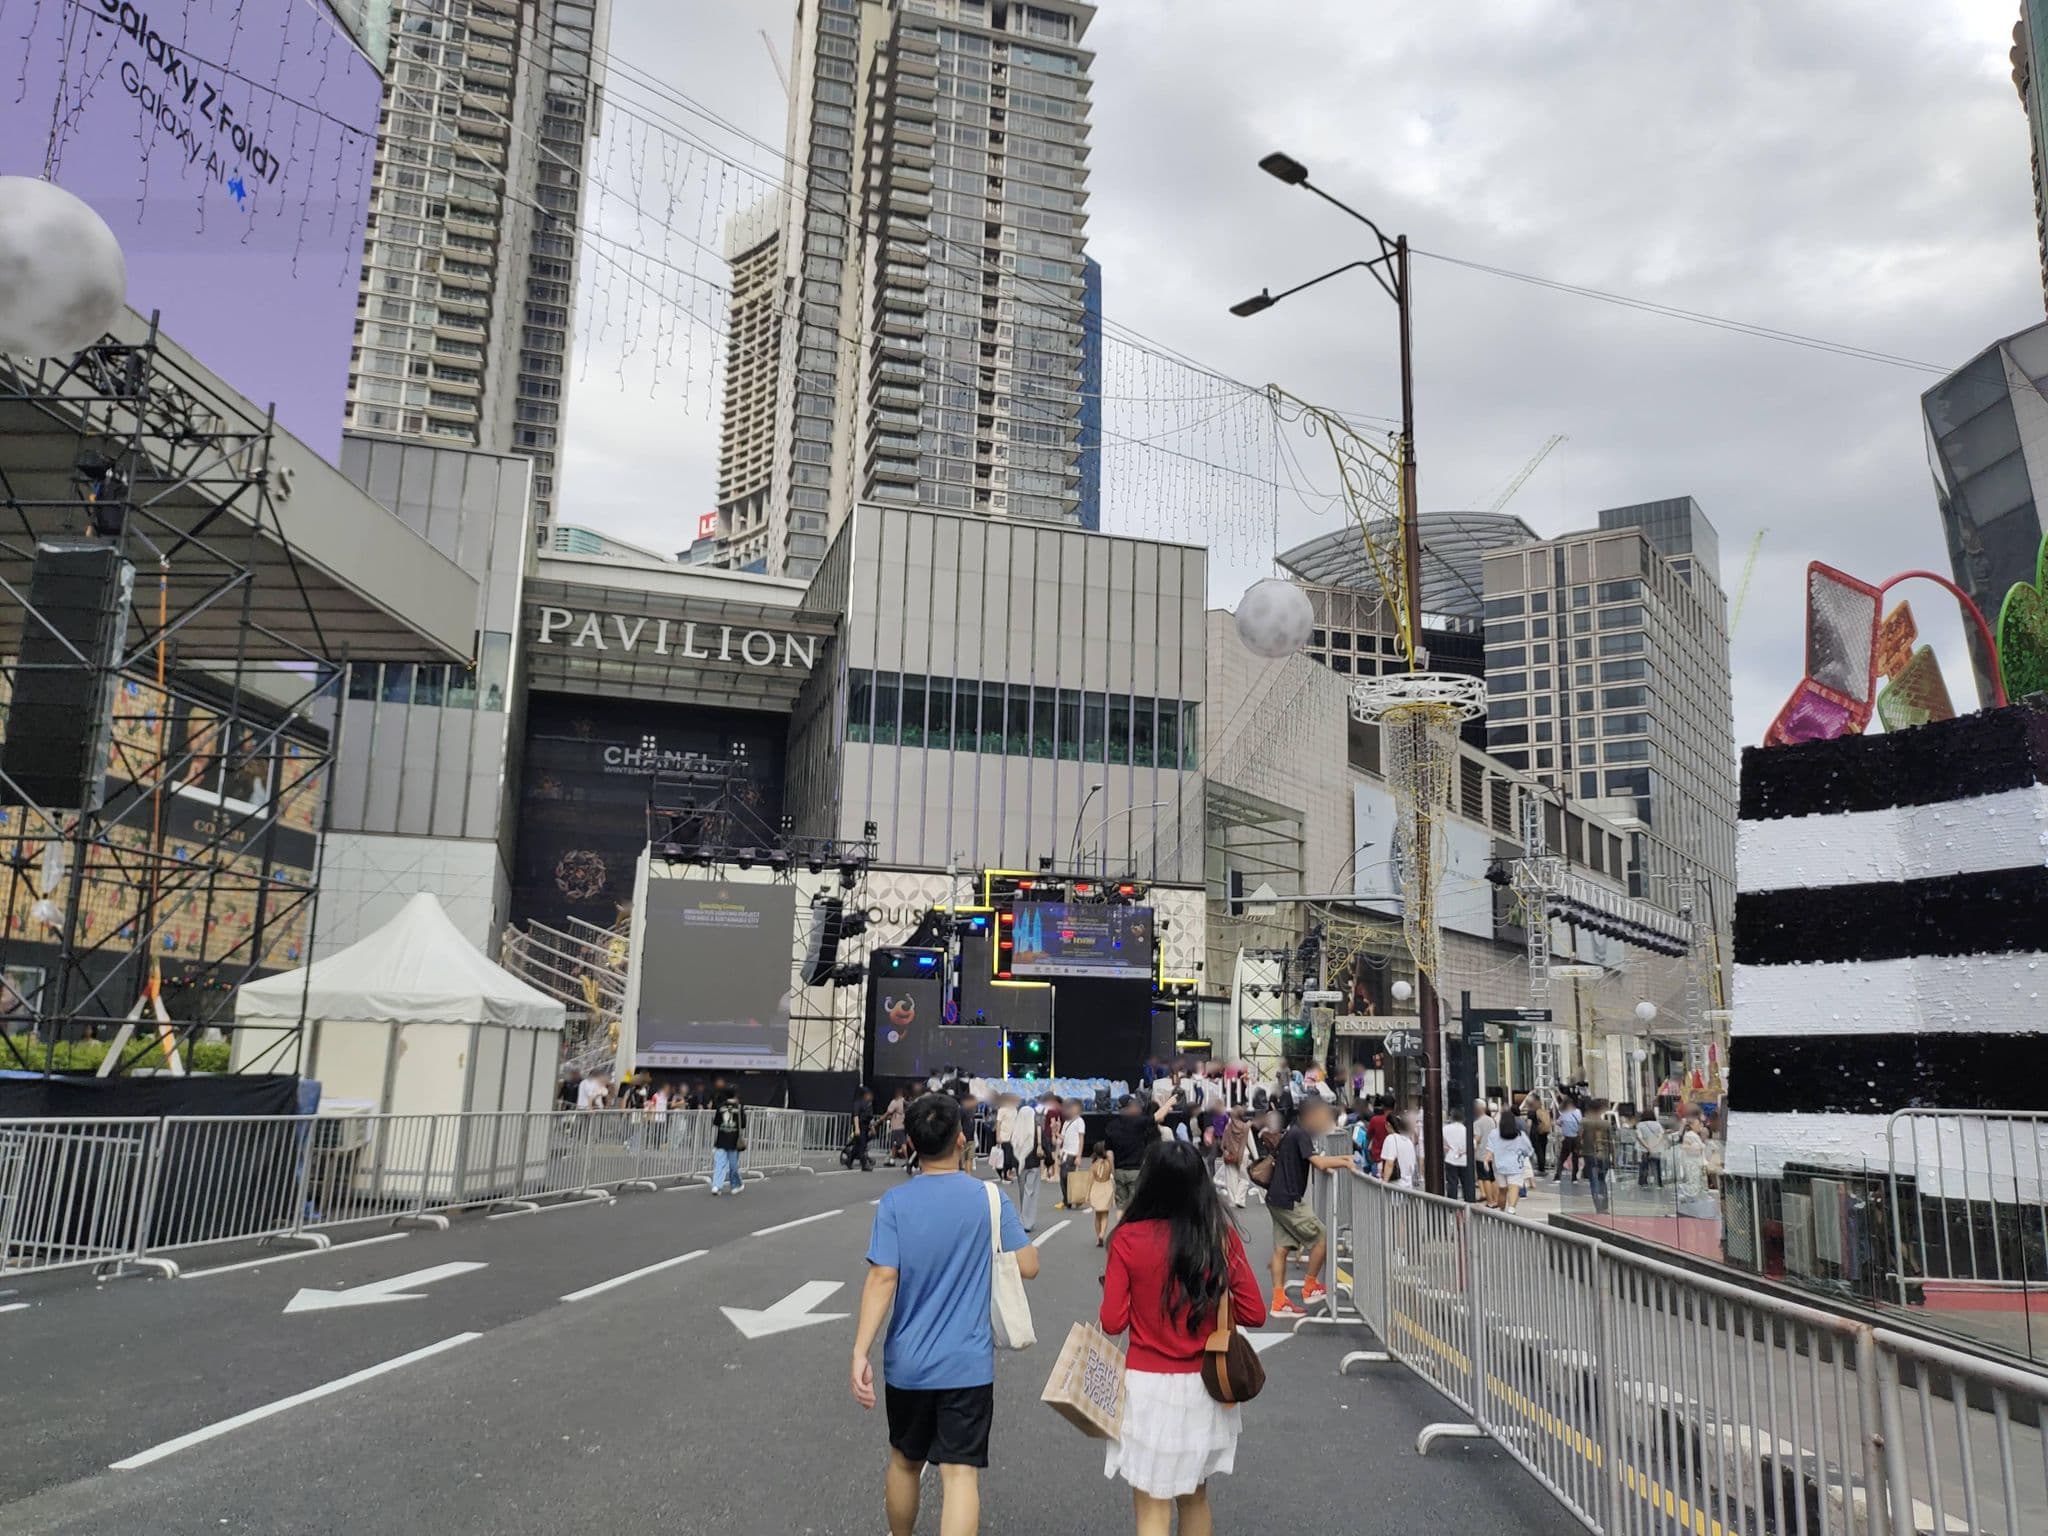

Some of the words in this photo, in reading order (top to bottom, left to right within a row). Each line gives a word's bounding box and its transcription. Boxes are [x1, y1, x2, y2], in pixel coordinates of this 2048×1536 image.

[121, 61, 203, 164] Galaxy
[205, 150, 226, 184] AI
[199, 82, 217, 122] Z
[219, 103, 280, 184] Fold7
[538, 606, 818, 670] PAVILION
[867, 906, 923, 926] OUIS
[1344, 1019, 1410, 1031] ENTRANCE
